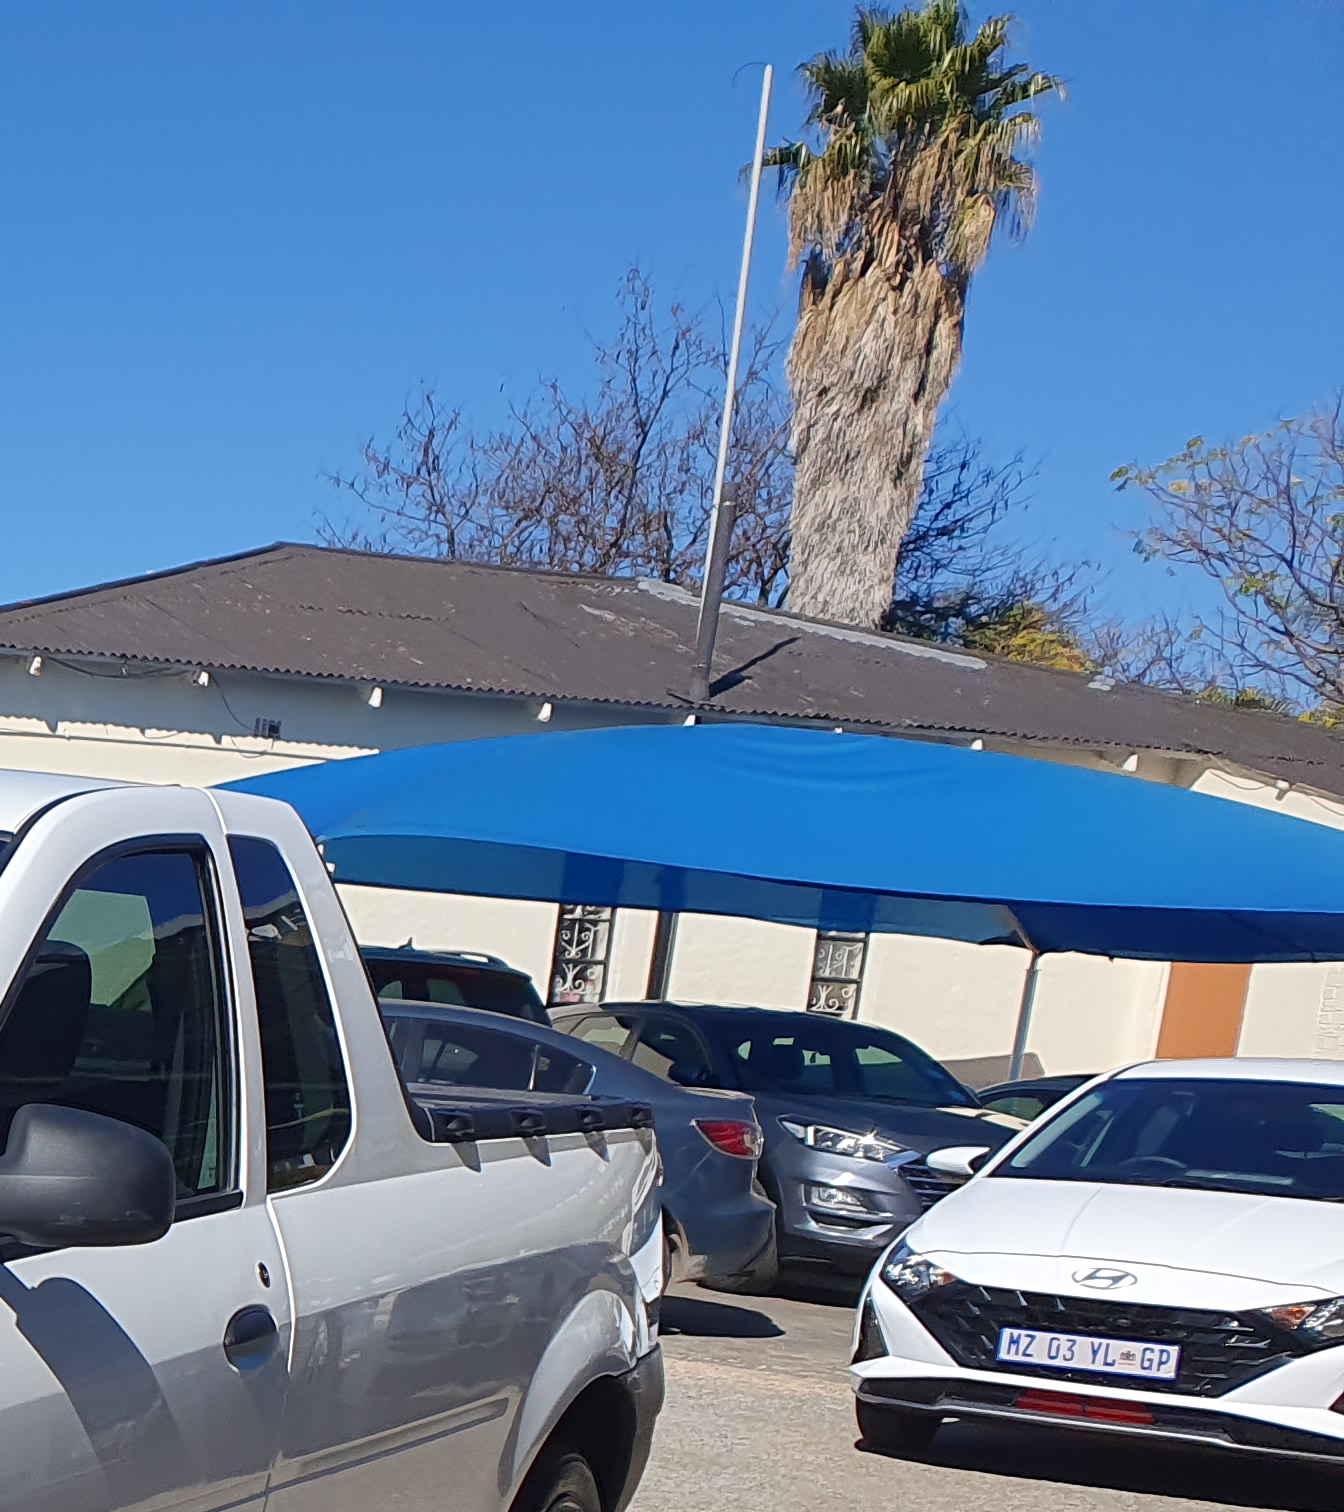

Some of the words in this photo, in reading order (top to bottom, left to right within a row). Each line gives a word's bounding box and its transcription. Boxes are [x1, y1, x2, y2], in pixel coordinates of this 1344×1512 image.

[1006, 1331, 1037, 1358] MZ
[1047, 1337, 1077, 1362] 03
[1089, 1340, 1116, 1367] YL
[1140, 1346, 1171, 1372] GP
